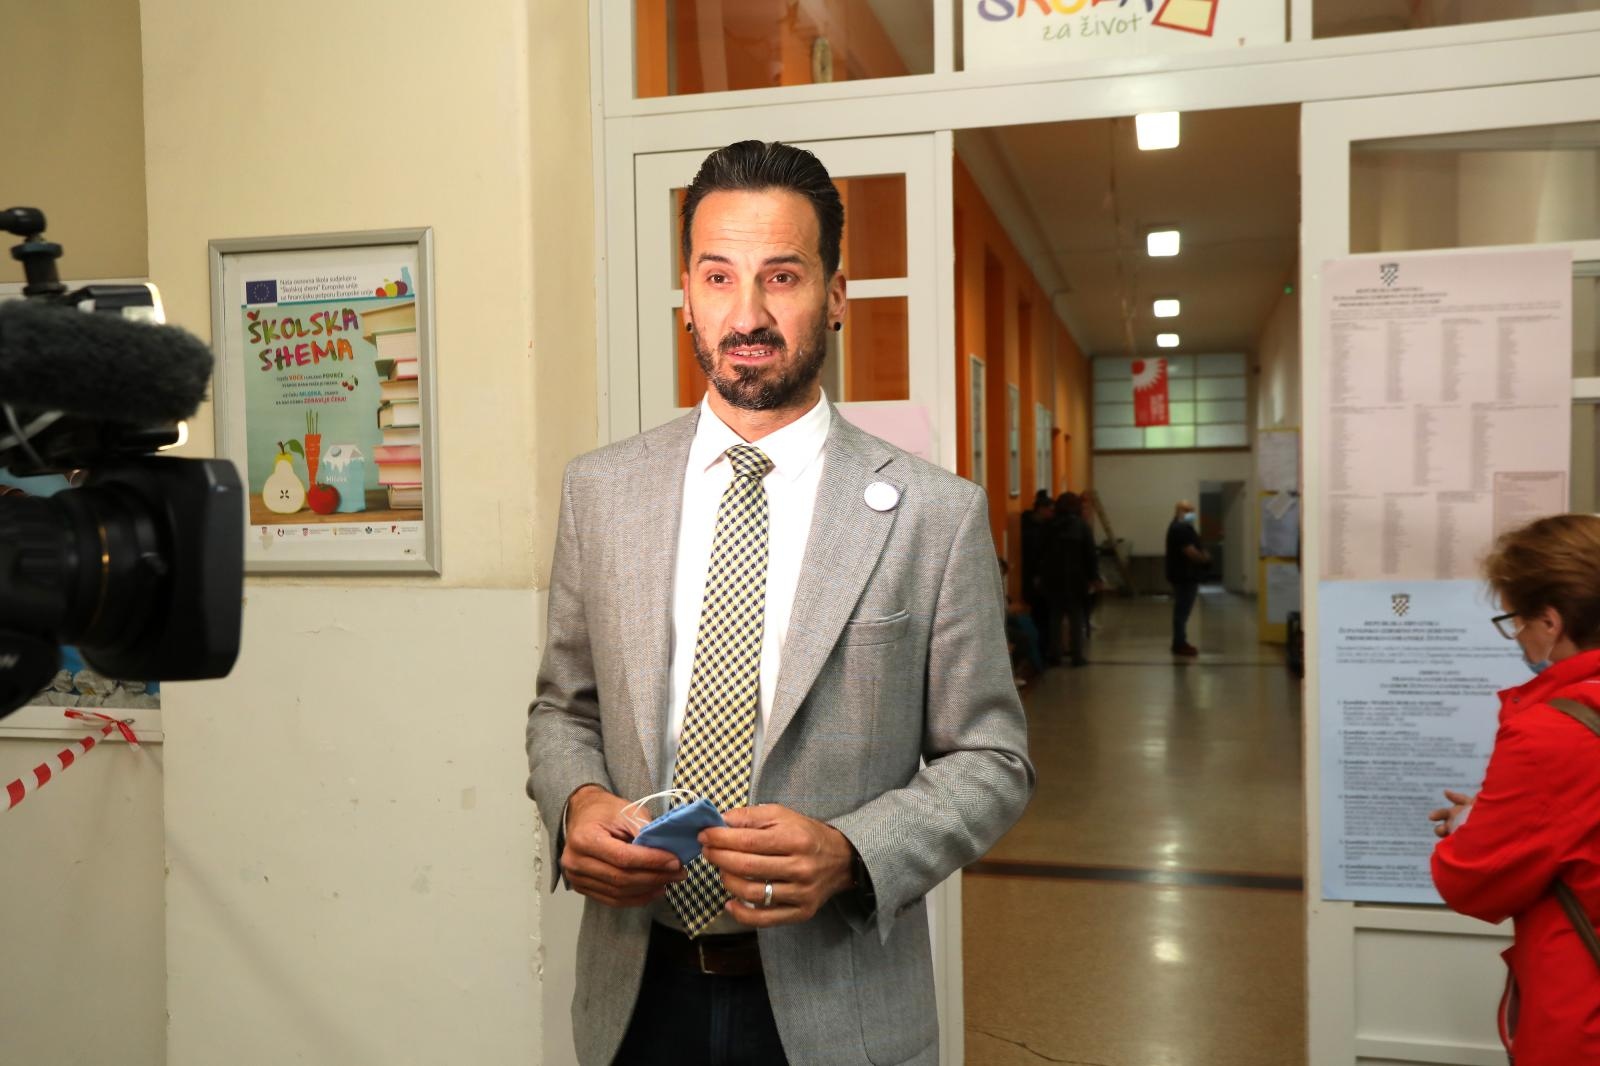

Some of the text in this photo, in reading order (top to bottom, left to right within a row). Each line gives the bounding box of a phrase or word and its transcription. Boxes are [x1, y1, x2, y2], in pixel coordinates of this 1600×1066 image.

[1042, 13, 1143, 41] za život
[246, 308, 359, 345] ŠKOLSKA
[258, 338, 354, 371] SHEMA
